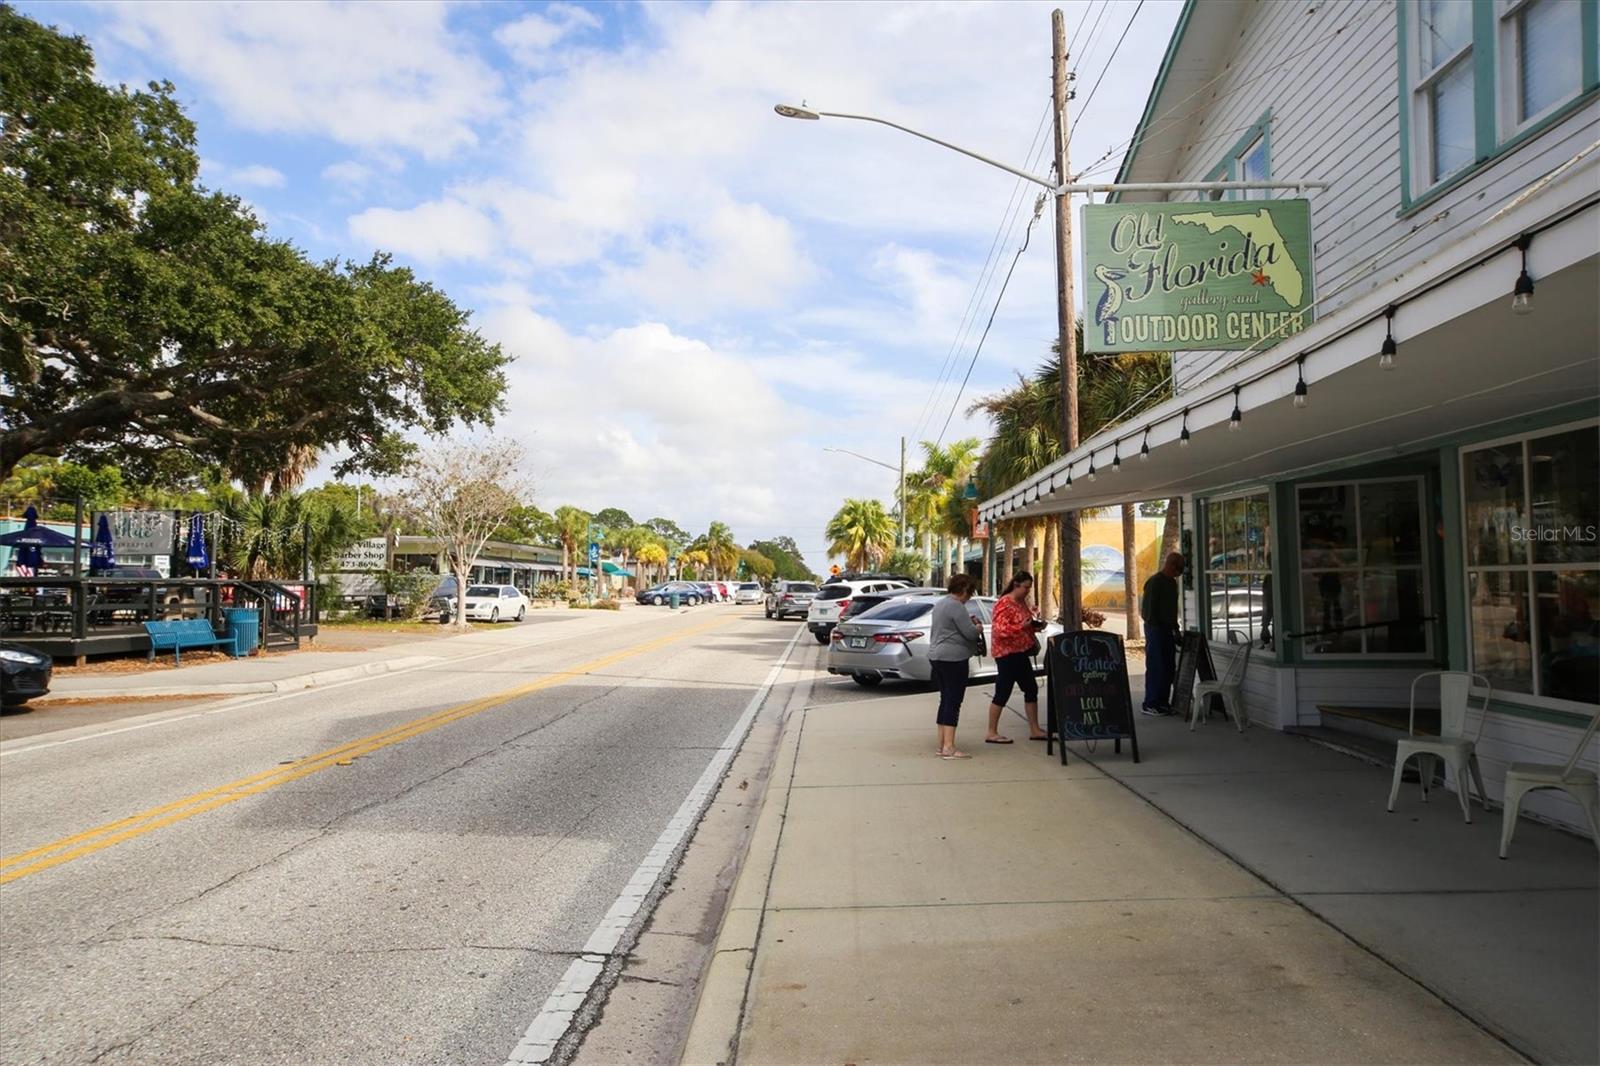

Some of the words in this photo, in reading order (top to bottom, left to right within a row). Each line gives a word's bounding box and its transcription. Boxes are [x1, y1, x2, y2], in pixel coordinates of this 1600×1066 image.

[1110, 211, 1166, 254] Old
[1125, 231, 1281, 303] Florida
[1178, 288, 1227, 312] gallery
[1232, 290, 1260, 305] and
[1120, 313, 1219, 343] OUTDOOR
[1226, 311, 1304, 340] CENTER
[364, 551, 385, 560] Shop
[1060, 635, 1090, 657] Old
